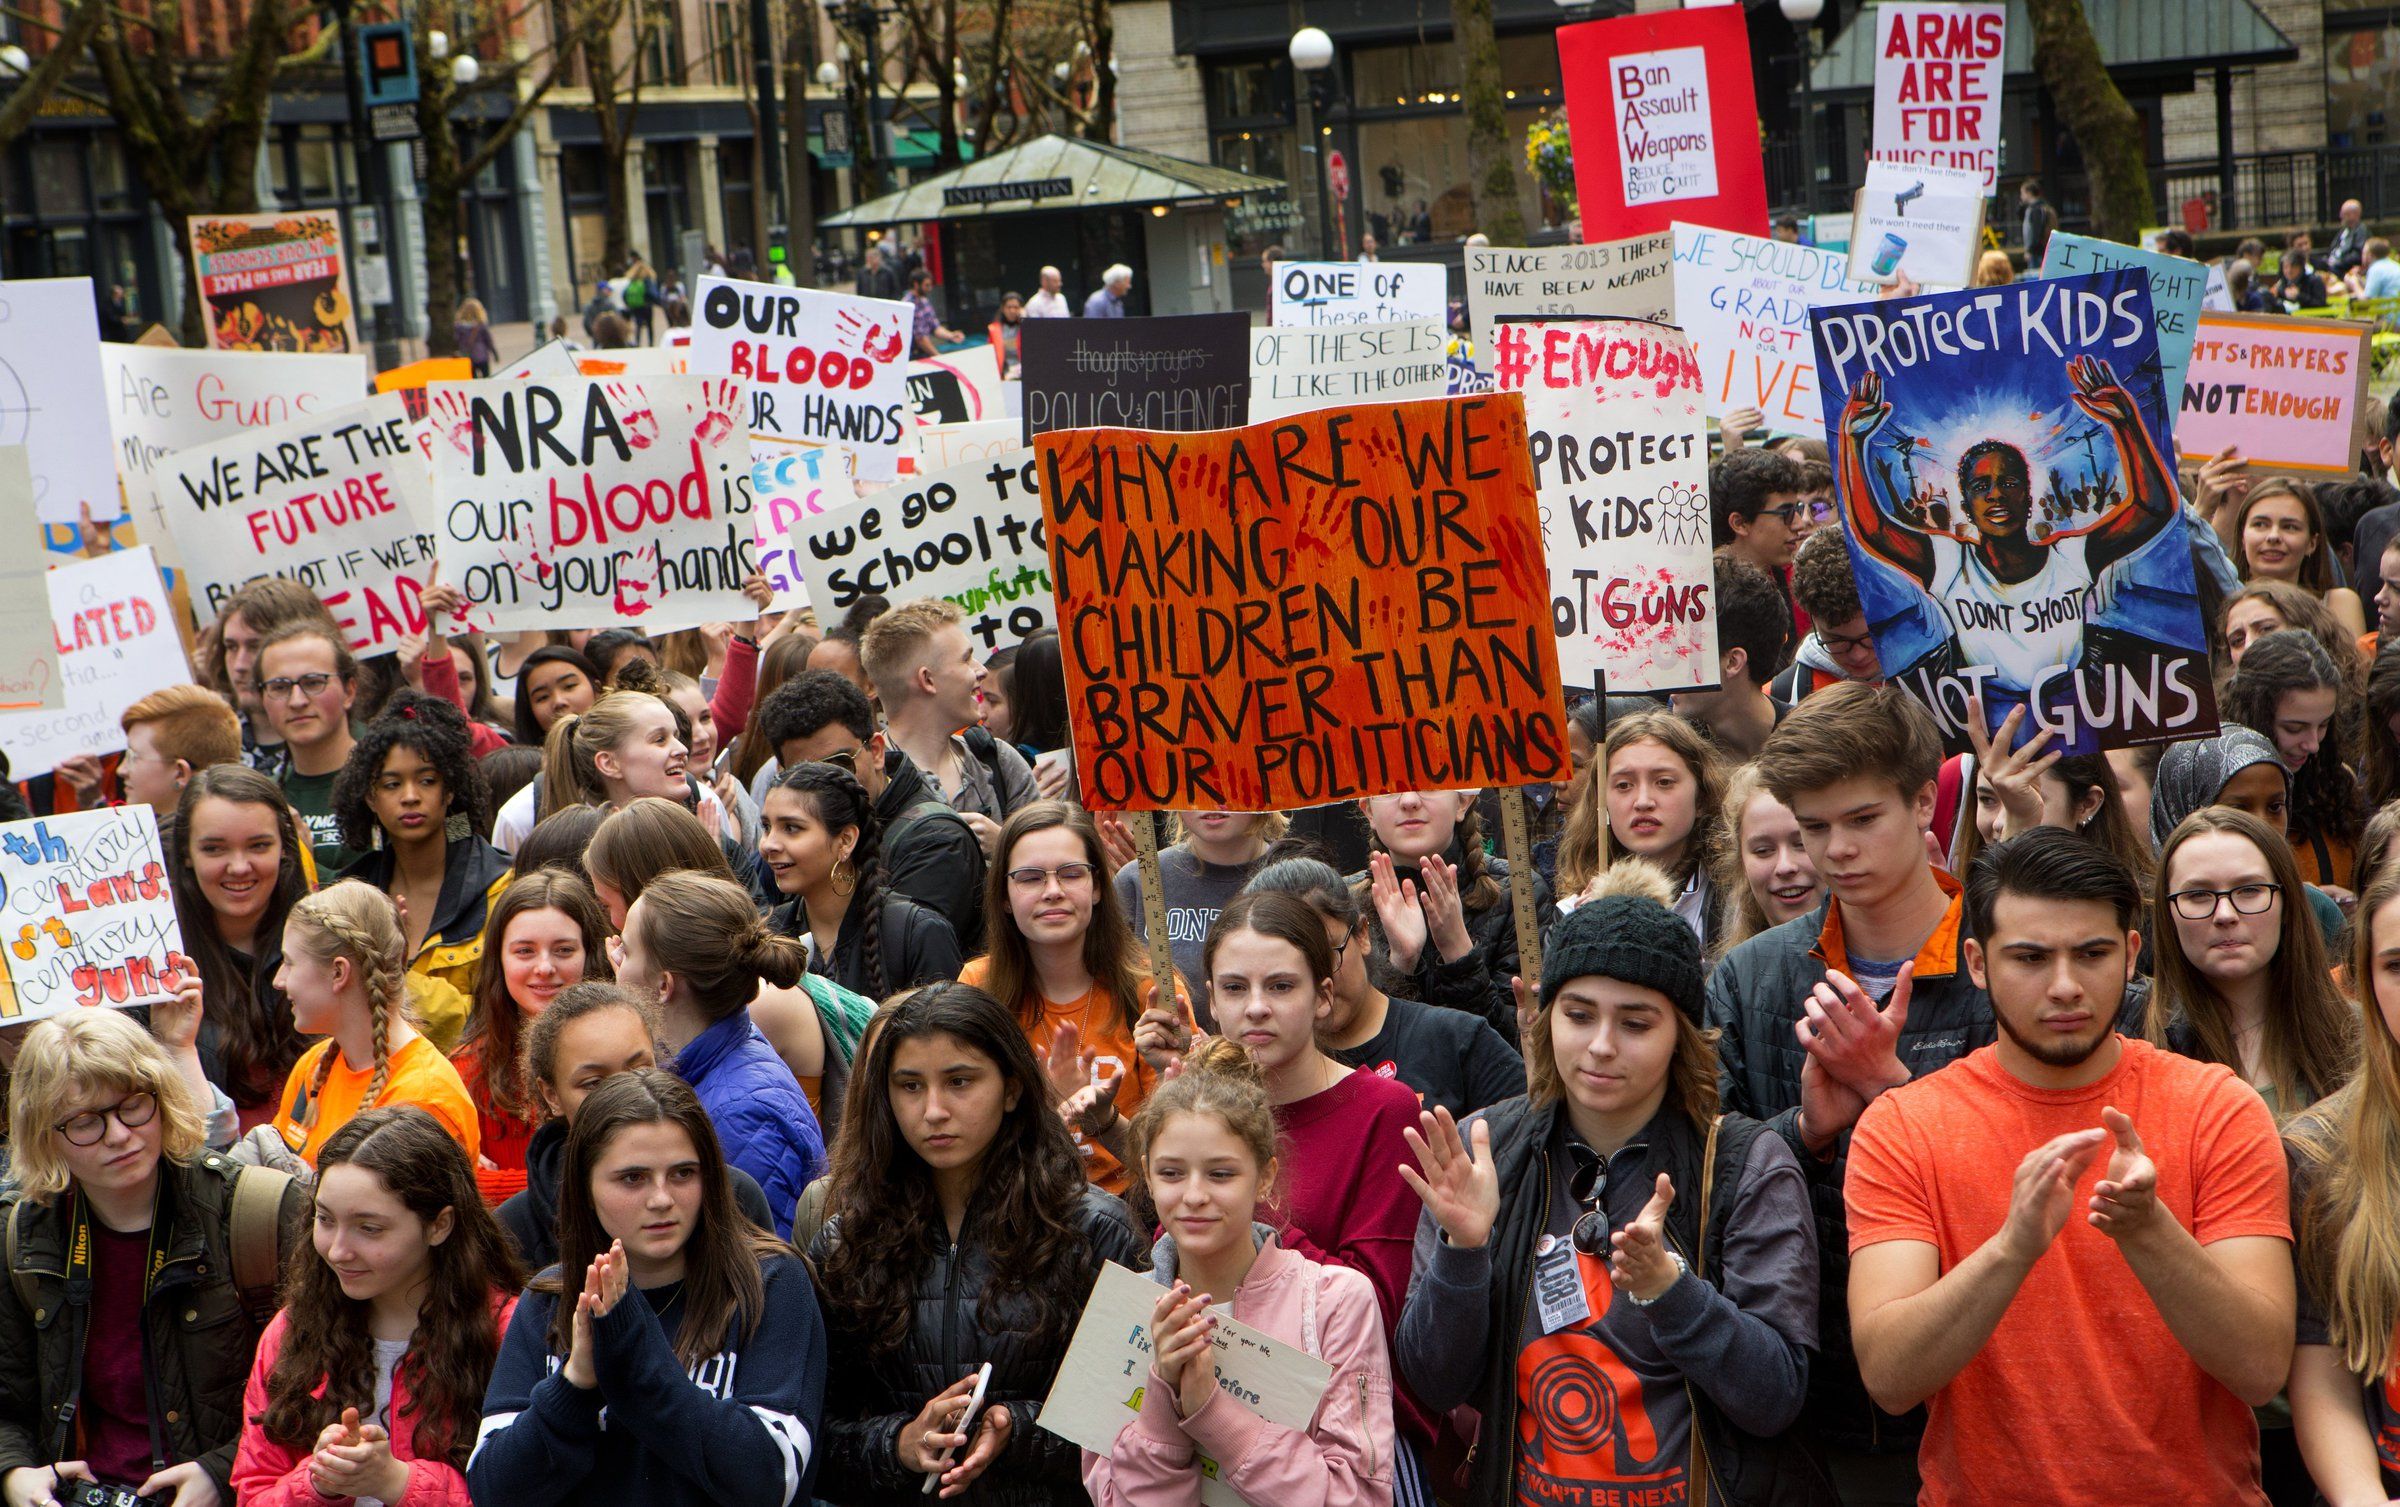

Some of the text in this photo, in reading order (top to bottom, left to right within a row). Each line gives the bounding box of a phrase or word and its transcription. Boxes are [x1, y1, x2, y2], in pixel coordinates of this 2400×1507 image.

[1885, 13, 2002, 58] ARMS
[1618, 65, 1670, 100] Ban
[1898, 62, 1988, 104] ARE
[1623, 88, 1698, 131] Assault
[1902, 106, 1982, 143] FOR
[1624, 132, 1706, 163] Weapons
[947, 181, 1070, 204] INFORMATION
[1902, 164, 1922, 173] don't
[1924, 167, 1942, 176] have
[1945, 169, 1966, 178] these
[1869, 217, 1960, 232] We won't need these
[293, 259, 328, 280] FEAR
[1473, 237, 1672, 275] SINCE 2013 THERE
[1673, 233, 1716, 266] WE
[1725, 238, 1819, 281] SHOULD
[2060, 244, 2078, 269] I
[213, 273, 253, 294] PLACE
[1284, 270, 1355, 302] ONE
[1484, 261, 1669, 297] HAVE BEEN NEARLY
[1751, 277, 1805, 294] ABOUT OUR
[704, 285, 800, 337] OUR
[1302, 298, 1368, 326] These
[2020, 284, 2144, 358] KIDS
[1256, 324, 1442, 366] OF THESE IS
[1739, 321, 1801, 351] NOT
[731, 340, 874, 390] BLOOD
[1273, 363, 1445, 399] LIKE THE OTHERS
[2250, 343, 2348, 375] PRAYERS
[121, 364, 172, 419] Are
[1030, 390, 1136, 434] POLICY
[1144, 383, 1243, 430] CHANGE
[2181, 383, 2341, 421] NOT ENOUGH
[471, 383, 632, 476] NRA
[804, 394, 904, 445] HANDS
[179, 456, 244, 511] WE
[253, 435, 329, 495] ARE
[333, 418, 411, 465] THE
[751, 448, 824, 494] ECT
[1046, 401, 1500, 524] WHY ARE WE
[1529, 430, 1695, 490] PROTECT
[247, 472, 396, 554] FUTURE
[448, 438, 751, 547] our blood is
[809, 507, 882, 560] we
[902, 482, 957, 529] go
[337, 550, 364, 580] IF
[464, 523, 756, 611] on your hands
[828, 515, 992, 607] school
[1055, 490, 1486, 603] MAKING OUR
[52, 596, 156, 655] LATED
[1073, 560, 1517, 682] CHILDREN BE
[1601, 578, 1709, 629] GUNS
[1955, 587, 2082, 633] DONT SHOOT
[971, 606, 1043, 648] to
[1085, 626, 1546, 751] BRAVER THAN
[1897, 654, 2198, 746] NOT GUNS
[1094, 711, 1561, 804] OUR POLITICIANS
[2, 811, 157, 915] th century
[57, 861, 169, 914] Laws,
[11, 915, 73, 960] st
[21, 913, 176, 1005] century
[72, 951, 186, 1007] guns
[74, 1224, 87, 1265] Nikon
[1127, 1324, 1152, 1354] Fix
[1222, 1326, 1236, 1337] for
[1123, 1359, 1136, 1376] I
[1528, 1474, 1687, 1507] WON'T BE NEXT
